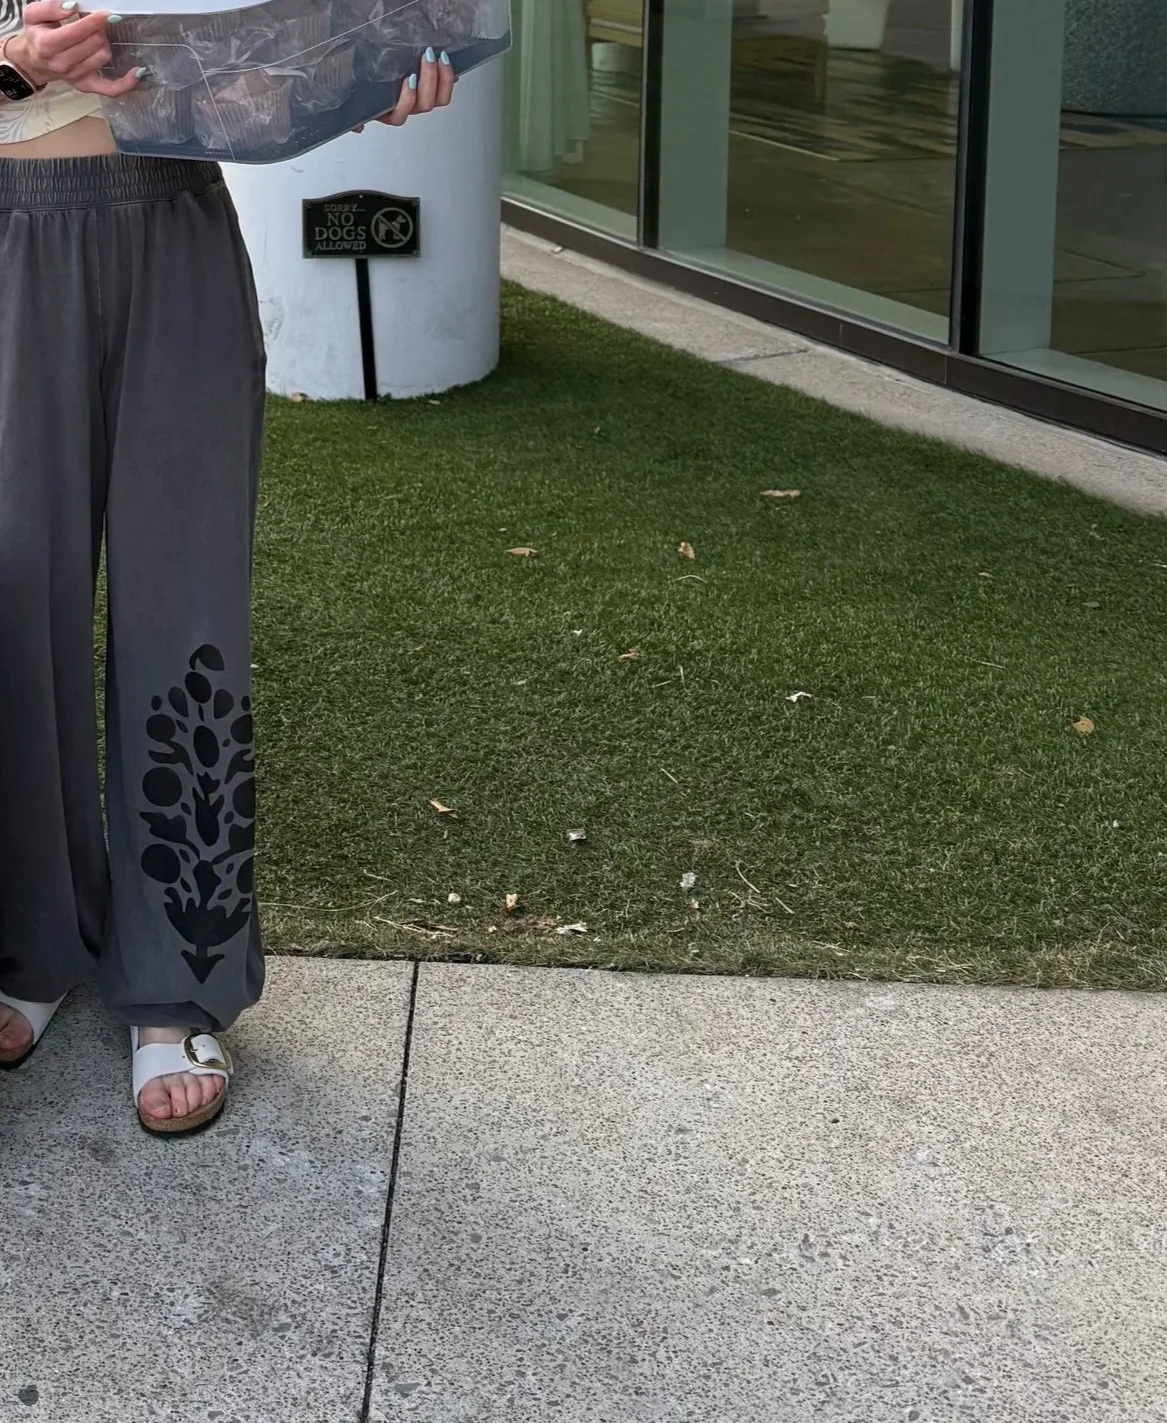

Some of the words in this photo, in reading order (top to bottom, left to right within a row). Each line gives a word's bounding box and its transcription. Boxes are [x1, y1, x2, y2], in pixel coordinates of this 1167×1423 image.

[327, 212, 354, 226] NO
[314, 226, 367, 241] DOGS
[315, 241, 367, 251] ALLOWED
